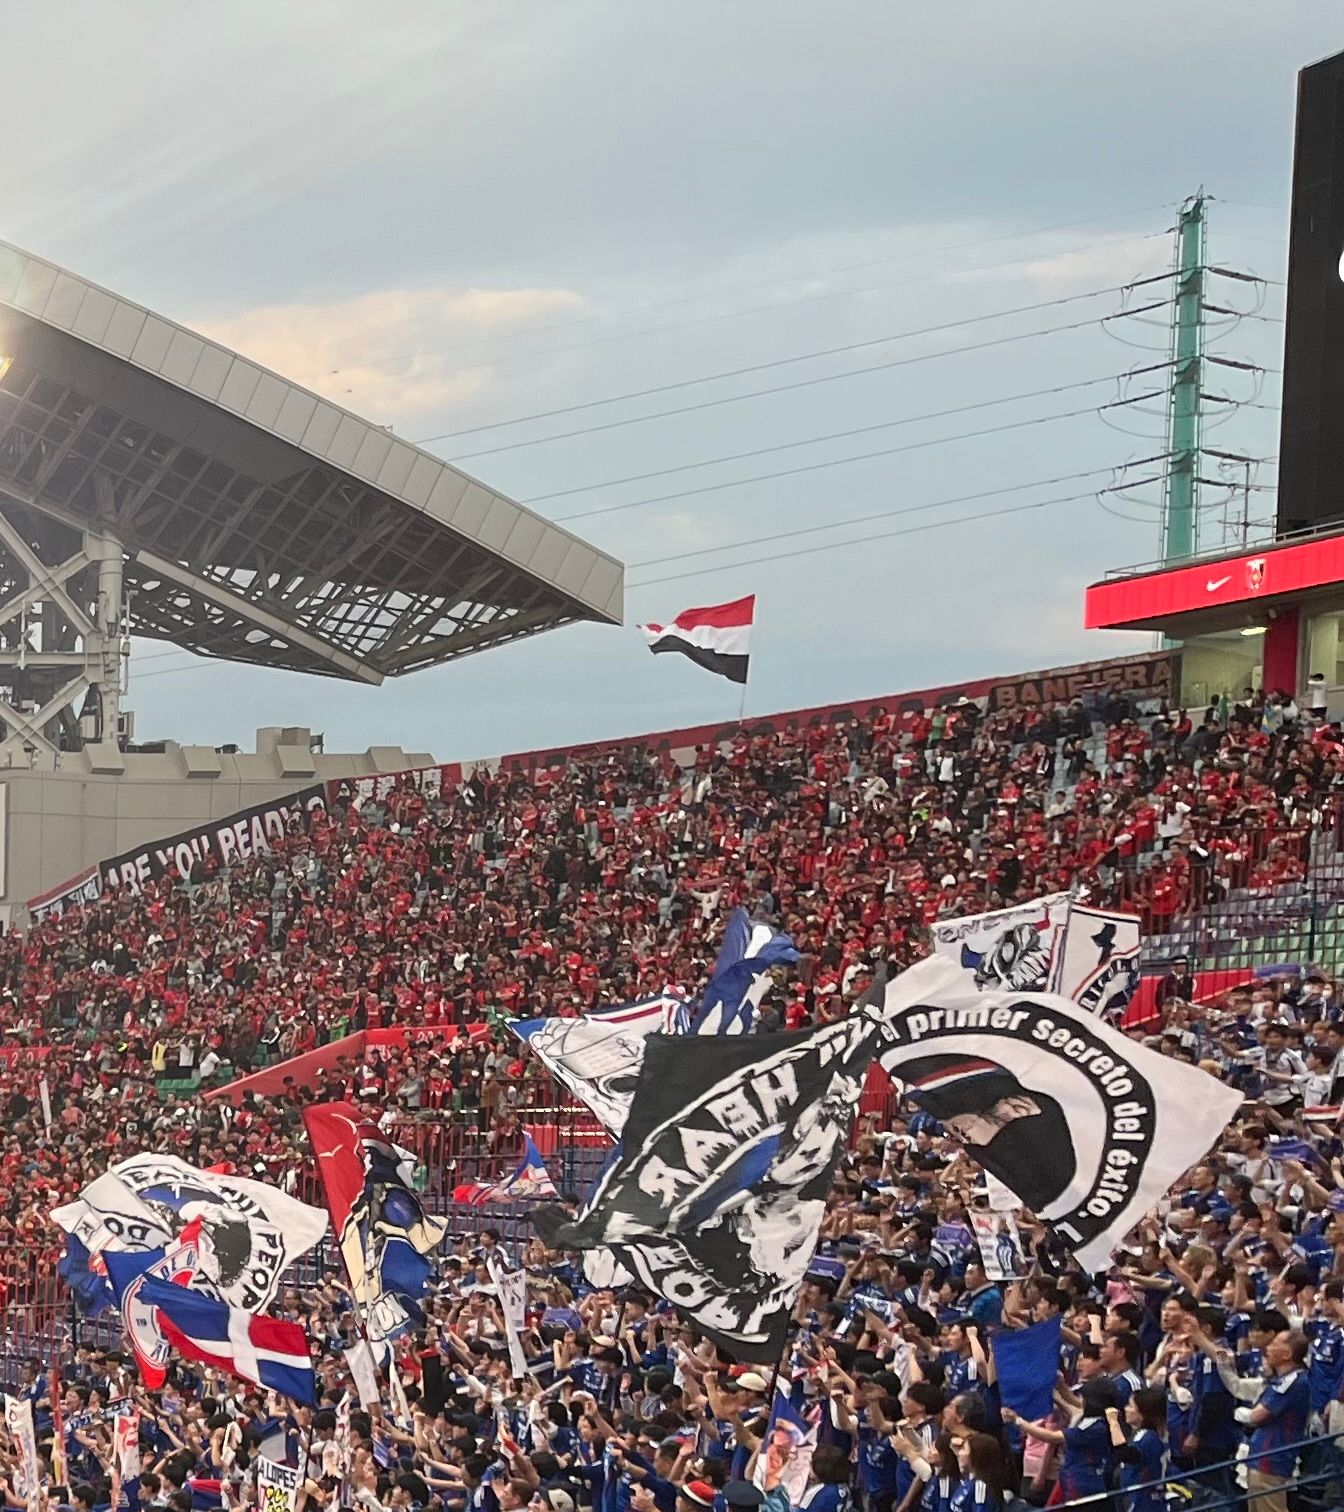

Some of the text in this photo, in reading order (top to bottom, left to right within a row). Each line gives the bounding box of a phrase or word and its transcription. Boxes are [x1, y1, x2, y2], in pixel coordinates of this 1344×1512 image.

[906, 1006, 1031, 1041] primer
[1031, 1017, 1135, 1099] secreto
[1113, 1101, 1148, 1142] del
